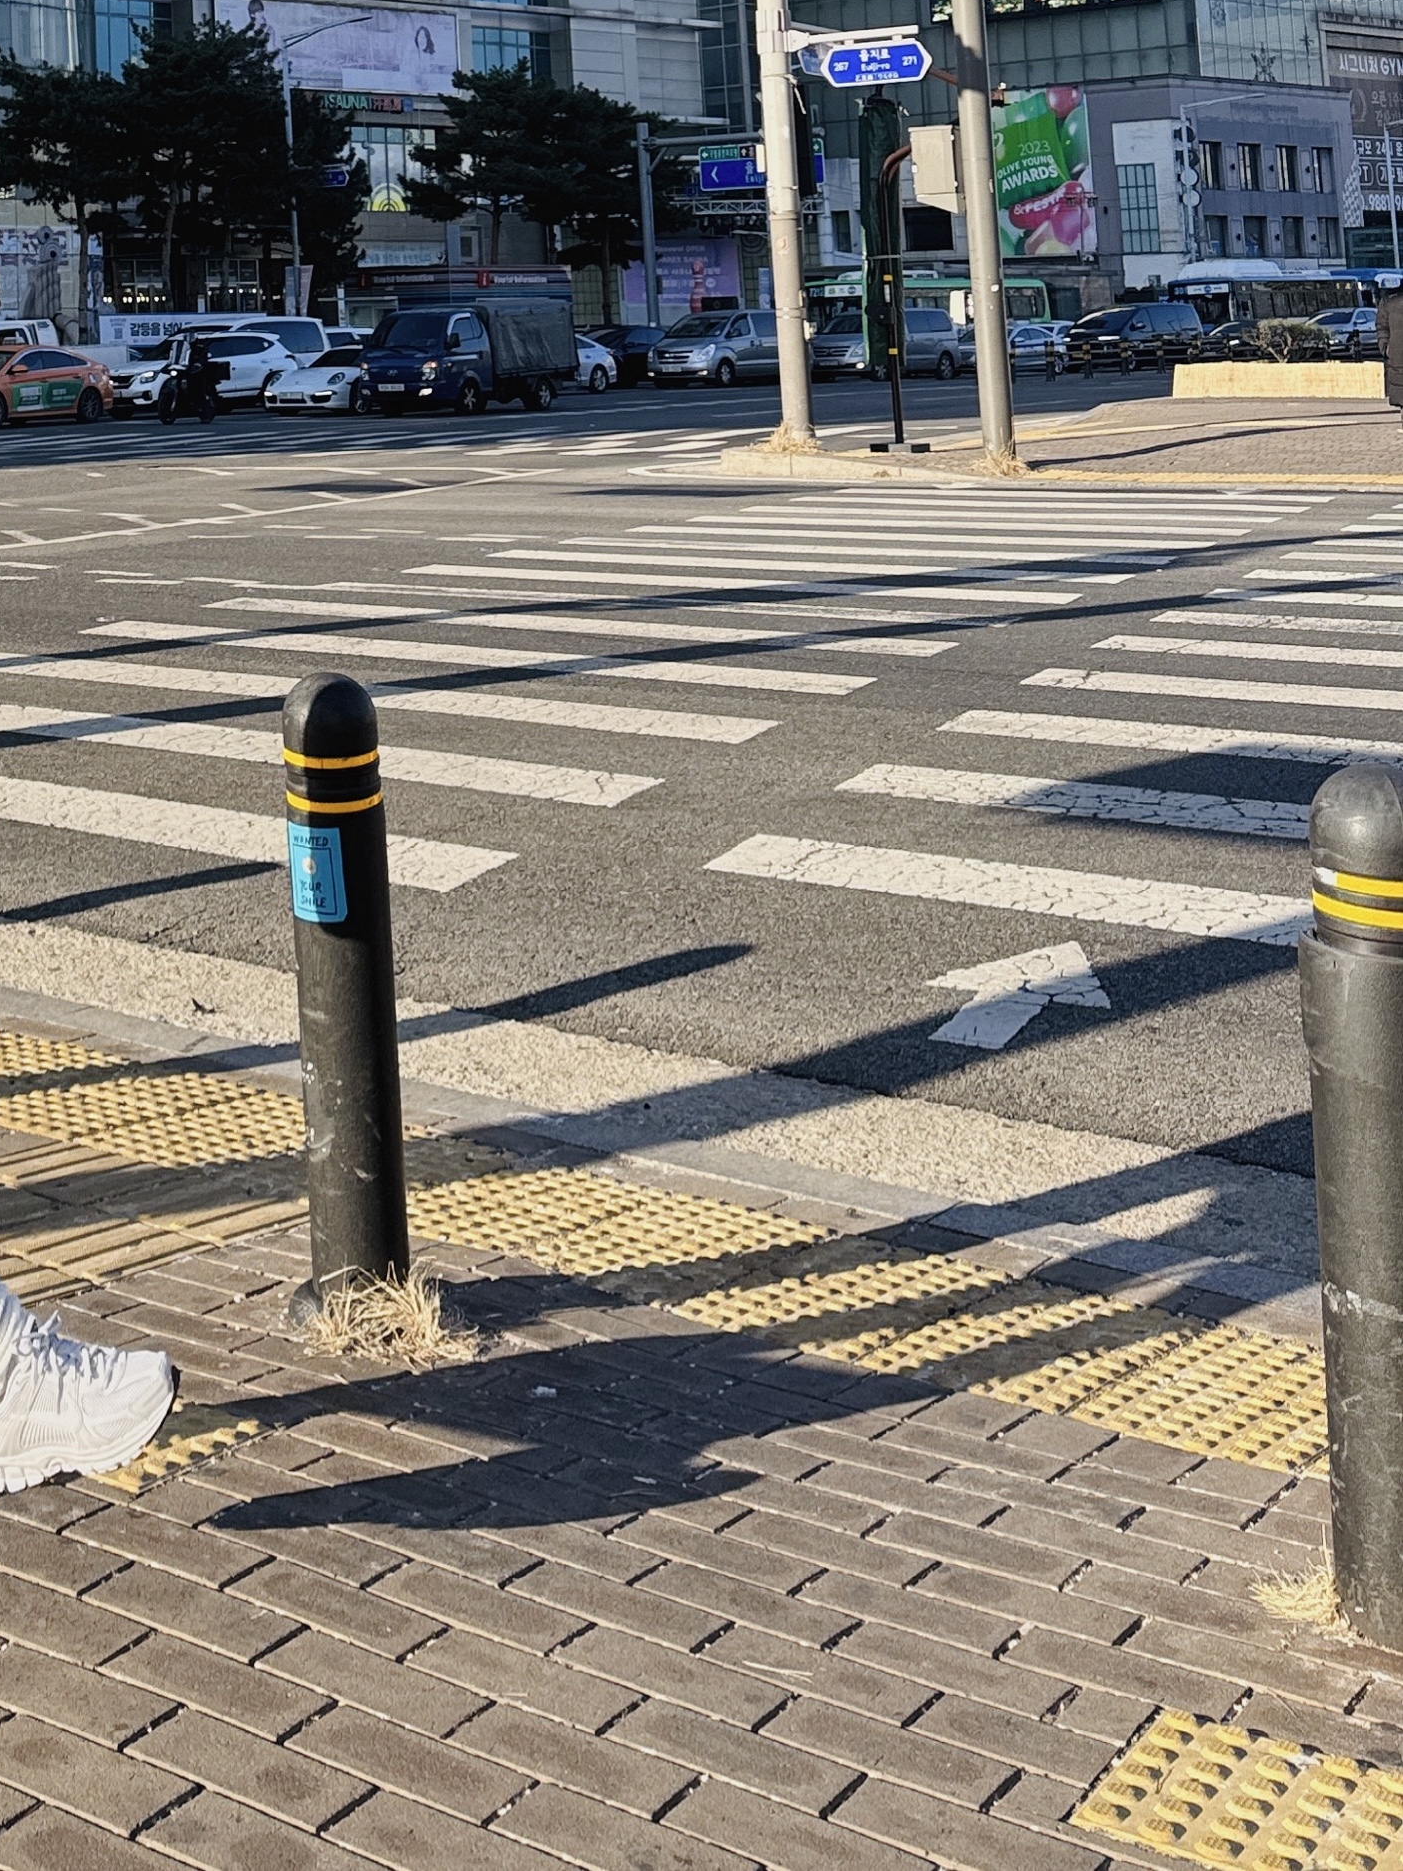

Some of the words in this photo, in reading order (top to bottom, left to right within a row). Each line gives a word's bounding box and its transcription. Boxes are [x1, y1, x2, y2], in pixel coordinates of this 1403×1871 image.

[1339, 53, 1378, 75] 시그니처
[1019, 140, 1051, 156] 2023
[997, 161, 1020, 178] OLIVE
[1022, 155, 1054, 167] YOUNG
[1001, 165, 1058, 193] AWARDS
[293, 835, 329, 847] WANTED
[300, 879, 322, 892] YOUR
[300, 895, 327, 908] SMILE
